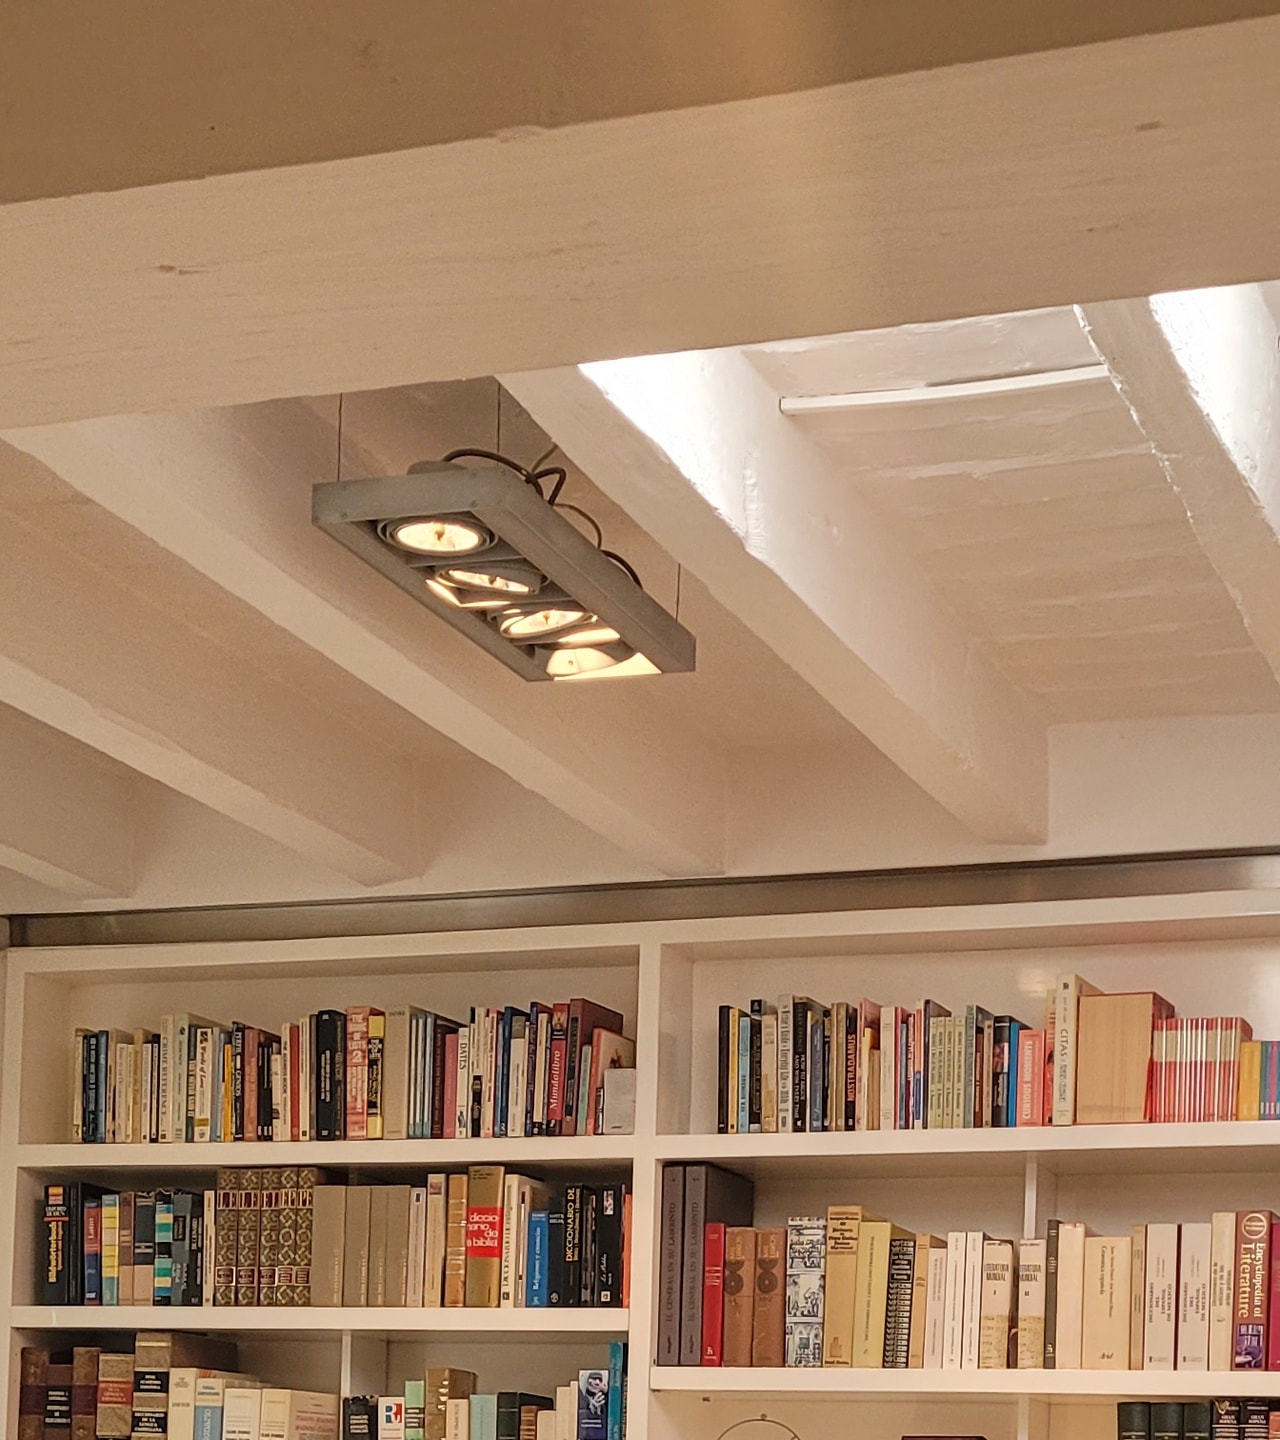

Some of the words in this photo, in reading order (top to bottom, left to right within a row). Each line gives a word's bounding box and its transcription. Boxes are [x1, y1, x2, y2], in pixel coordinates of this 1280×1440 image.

[352, 1050, 362, 1062] 2
[459, 1043, 467, 1070] DATES
[1024, 1041, 1032, 1080] MOMENTS
[1060, 1029, 1069, 1057] CITAS
[550, 1051, 561, 1109] Mundolibro
[847, 1034, 856, 1101] NOSTRADAMUS
[1023, 1084, 1032, 1118] CURIOUS
[566, 1202, 574, 1261] DICCIONARIO
[668, 1203, 676, 1246] LABERINTO
[690, 1202, 698, 1245] LABERINTO
[49, 1222, 57, 1283] Bildwörterbuch
[473, 1238, 498, 1247] biblia
[984, 1264, 1009, 1272] LITERATURA
[986, 1272, 1006, 1282] MUNDIAL
[1238, 1243, 1255, 1318] Literature
[1253, 1243, 1266, 1303] Encyclopedia
[666, 1276, 674, 1310] GENERAL
[1253, 1307, 1263, 1317] of
